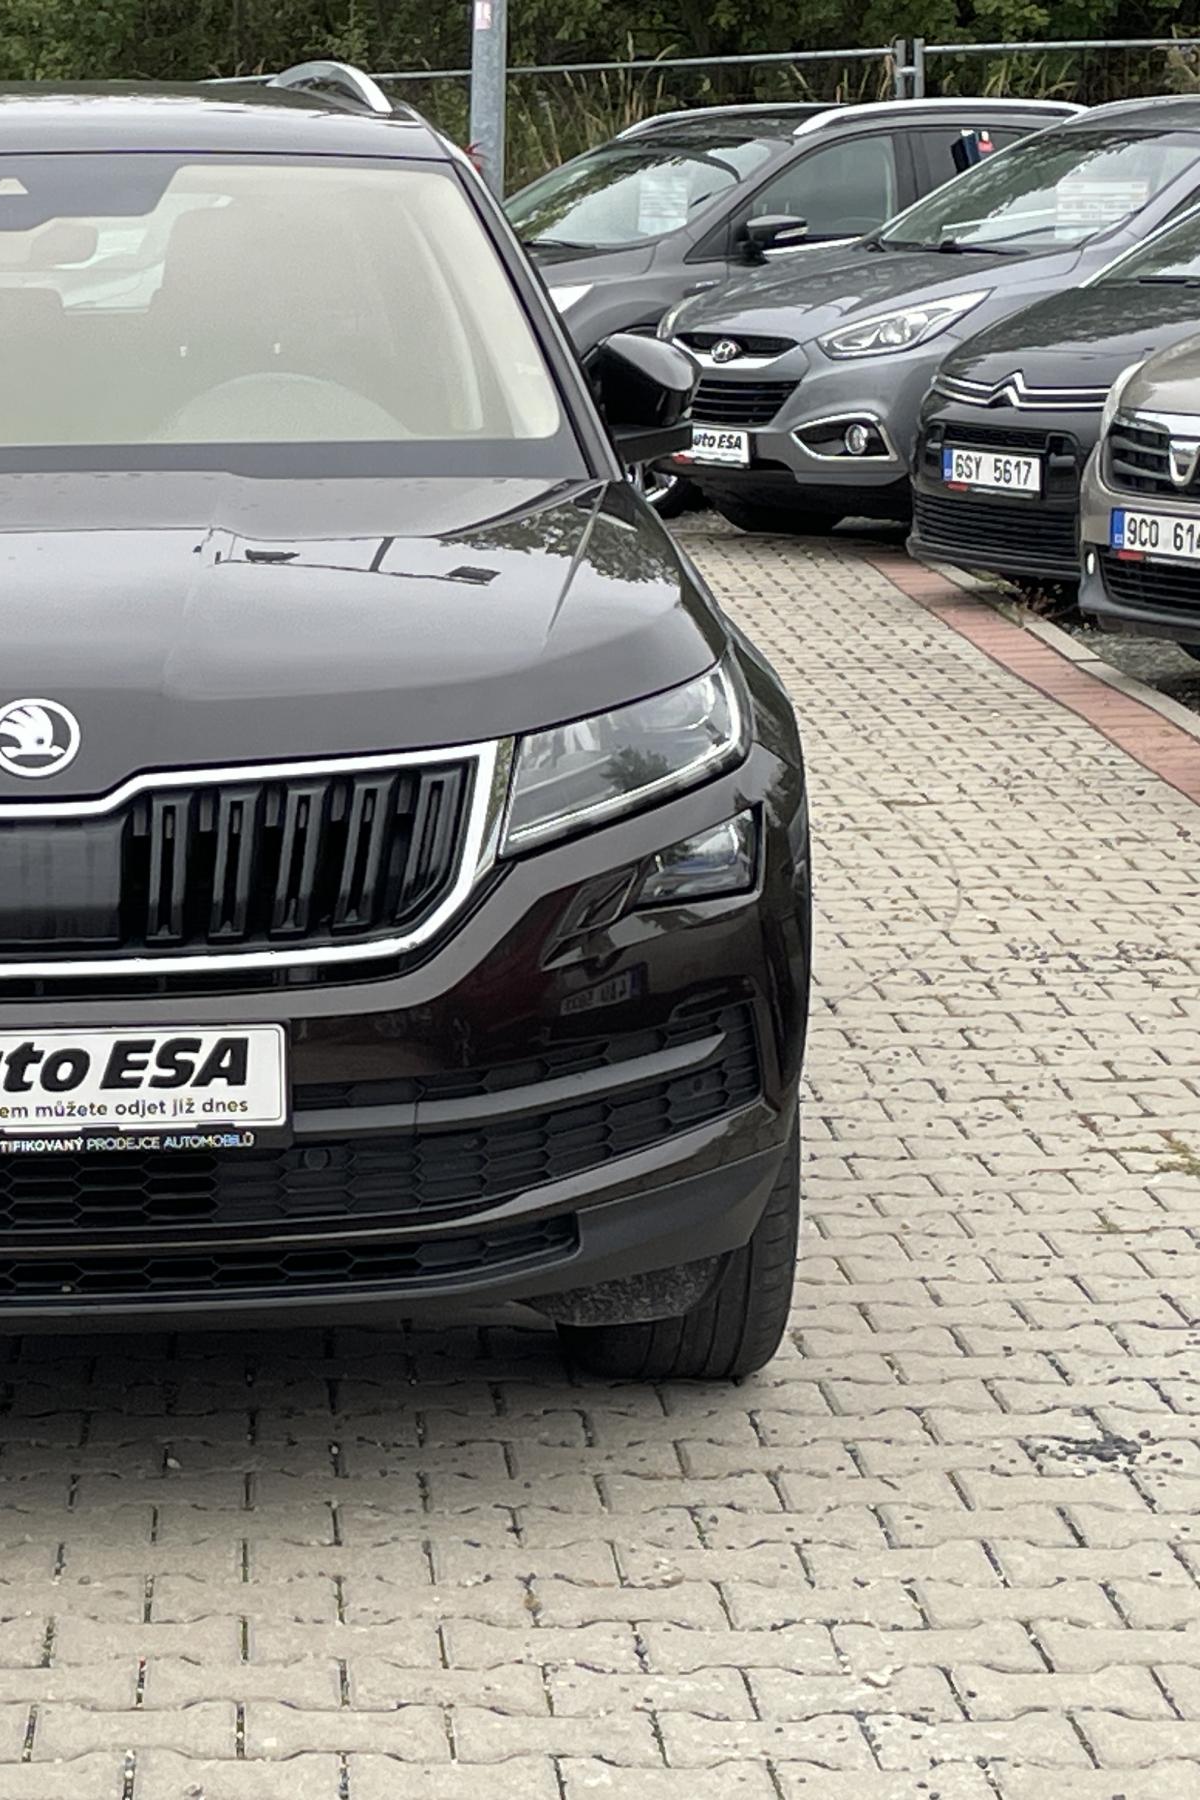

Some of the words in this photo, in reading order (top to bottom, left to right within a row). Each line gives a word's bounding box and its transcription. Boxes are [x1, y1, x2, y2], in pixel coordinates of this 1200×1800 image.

[717, 434, 742, 450] ESA
[955, 454, 982, 480] 6SY
[993, 457, 1032, 486] 5617
[1173, 522, 1200, 554] 61
[99, 1037, 249, 1090] ESA
[35, 1101, 108, 1117] můžete
[115, 1099, 166, 1118] odjet
[171, 1097, 195, 1116] již
[202, 1097, 249, 1112] dnes
[86, 1136, 160, 1151] PRODEJCE
[163, 1131, 255, 1150] AUTOMOBILŮ
